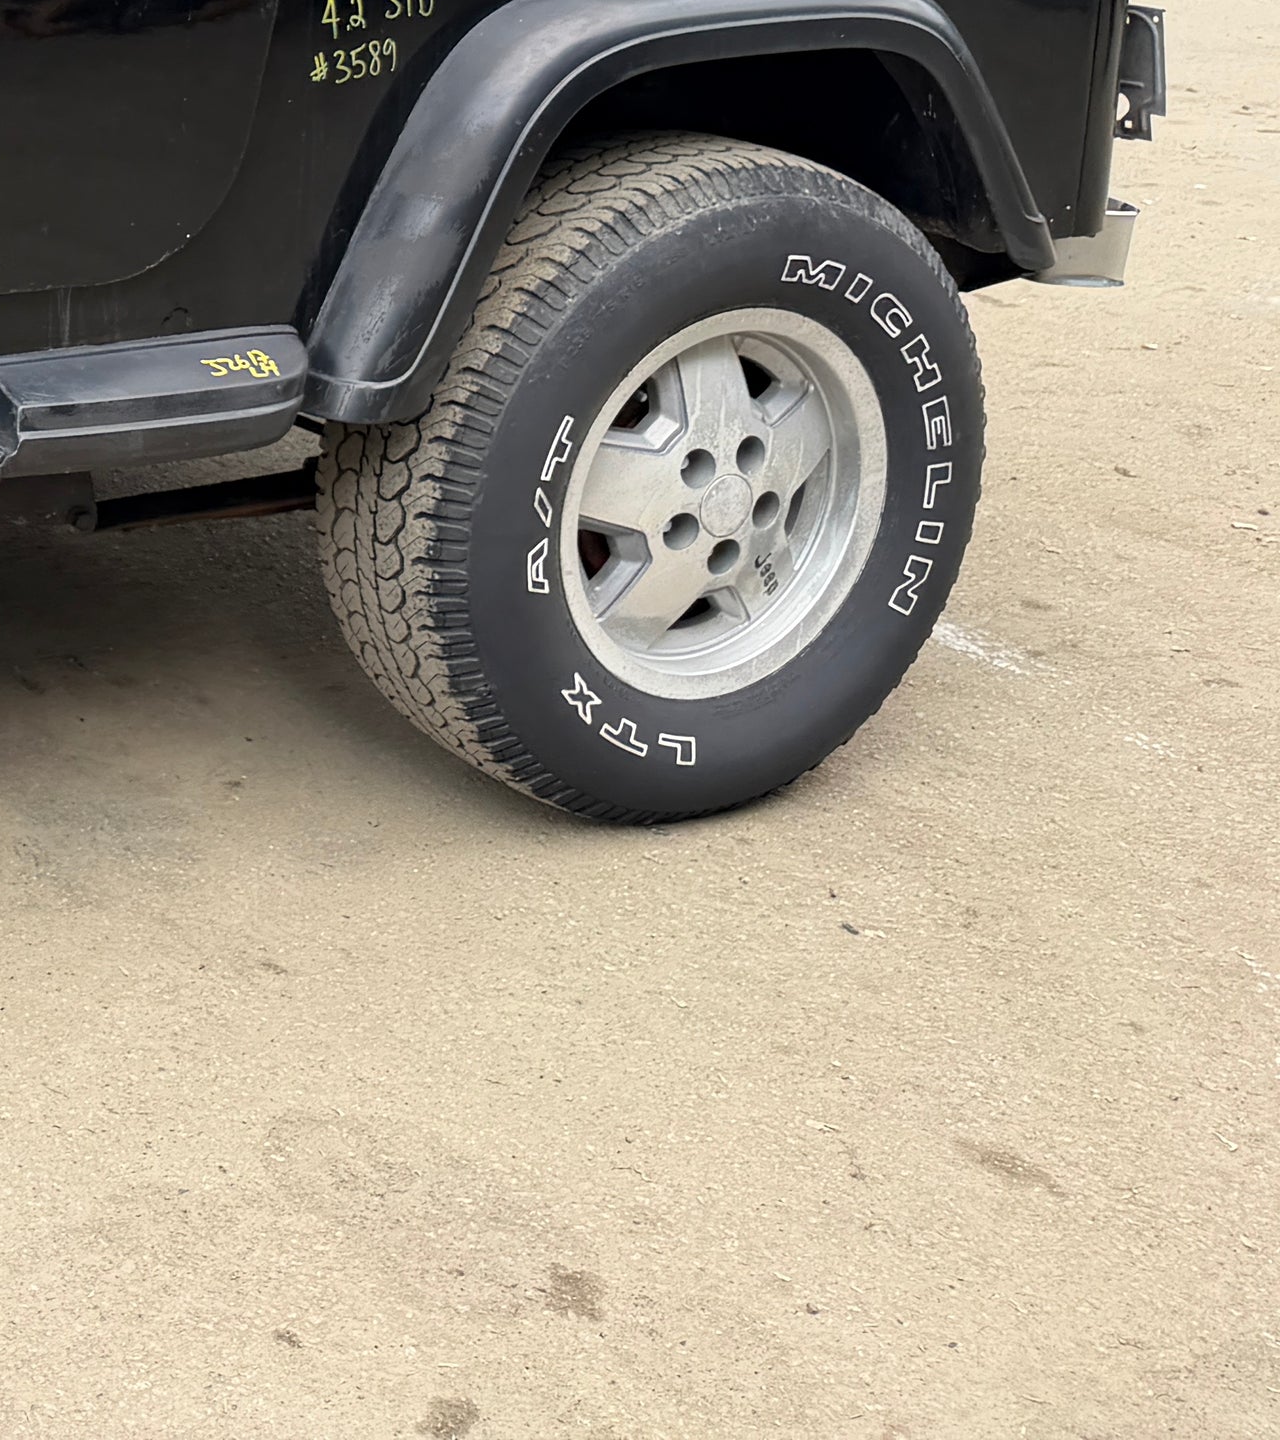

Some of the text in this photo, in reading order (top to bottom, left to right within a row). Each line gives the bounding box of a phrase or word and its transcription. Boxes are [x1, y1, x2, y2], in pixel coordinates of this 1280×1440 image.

[310, 37, 397, 84] #3589
[780, 254, 954, 617] MICHELIN
[526, 414, 575, 594] A/T
[754, 552, 779, 596] Jeep
[560, 672, 697, 767] LTX
